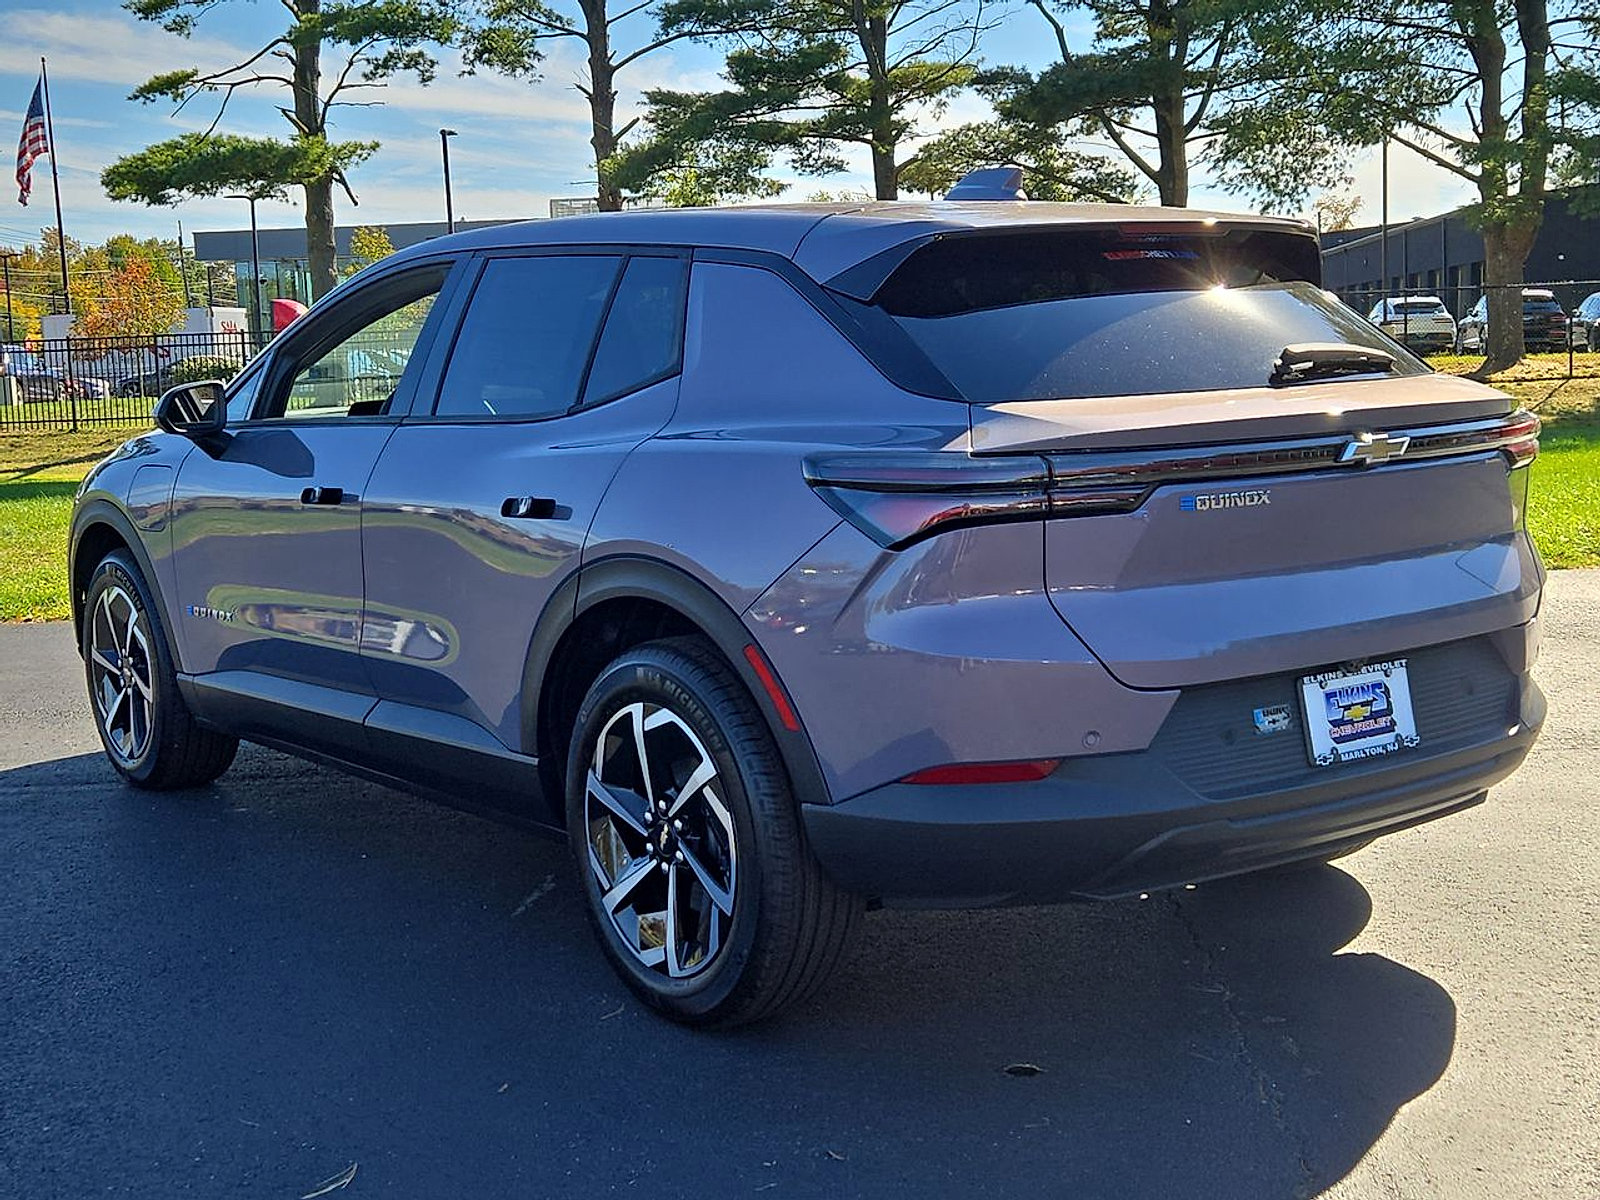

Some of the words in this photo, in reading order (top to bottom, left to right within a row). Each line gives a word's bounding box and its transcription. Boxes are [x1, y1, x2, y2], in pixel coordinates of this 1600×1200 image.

[1179, 490, 1271, 511] EQUINOX
[186, 605, 234, 622] EQUINOX
[1303, 670, 1344, 684] ELKINS
[1346, 659, 1407, 676] EVROLET
[1323, 680, 1388, 721] ELKINS
[664, 679, 722, 749] MICHELIN
[1341, 745, 1386, 761] MARLTON,
[1387, 742, 1399, 754] NJ
